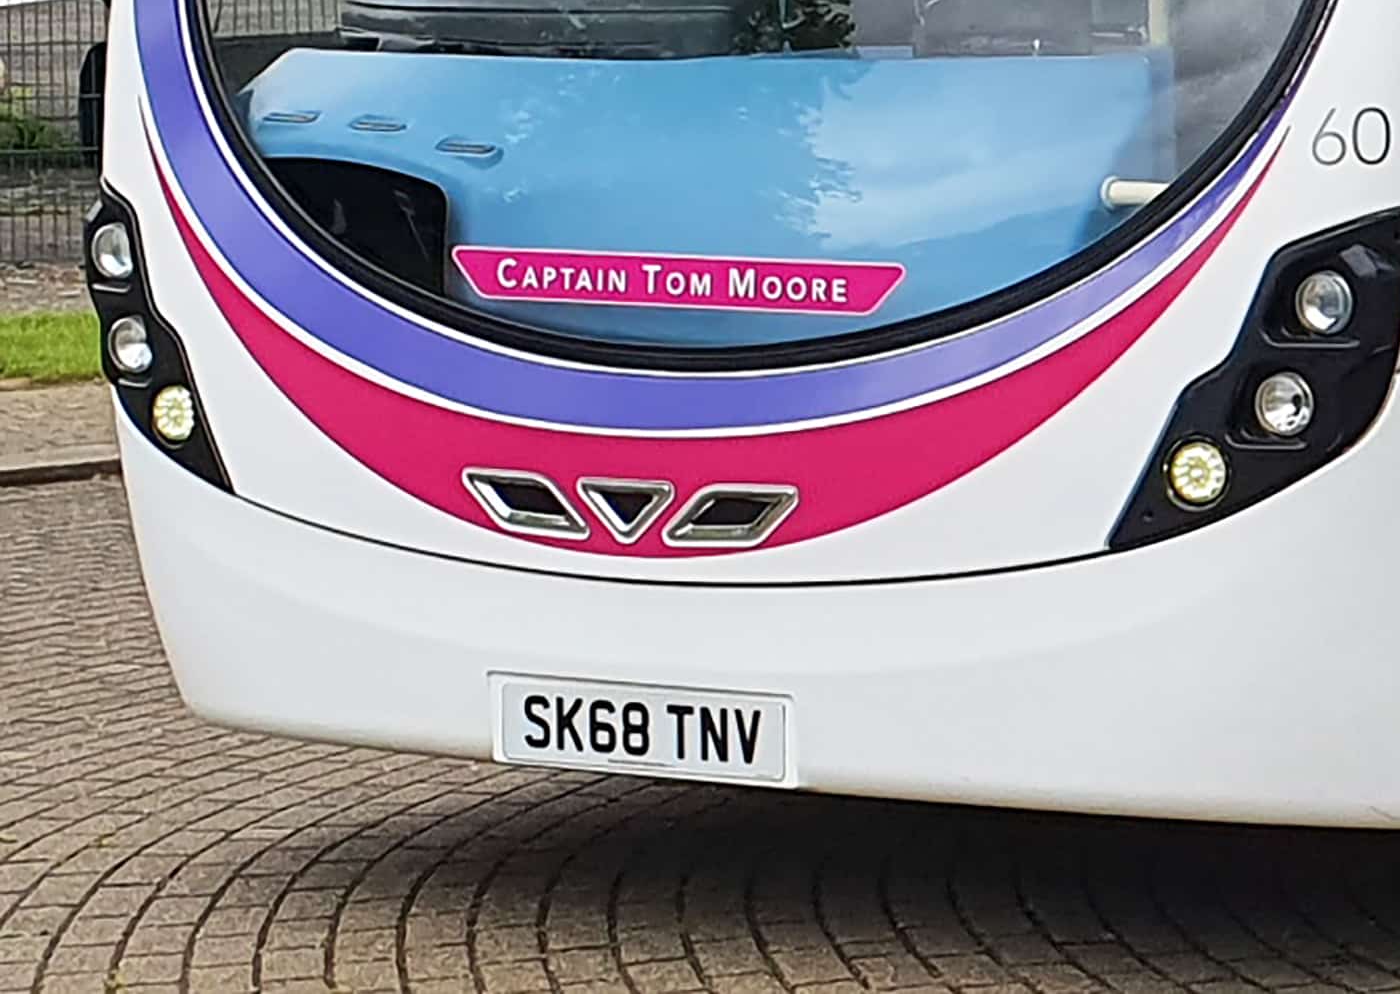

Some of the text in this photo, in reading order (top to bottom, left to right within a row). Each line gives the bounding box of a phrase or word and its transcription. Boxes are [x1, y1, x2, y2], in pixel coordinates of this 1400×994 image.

[1312, 107, 1391, 166] 60
[496, 258, 848, 303] CAPTAIN TOM MOORE
[523, 694, 762, 765] SK68 TNV
